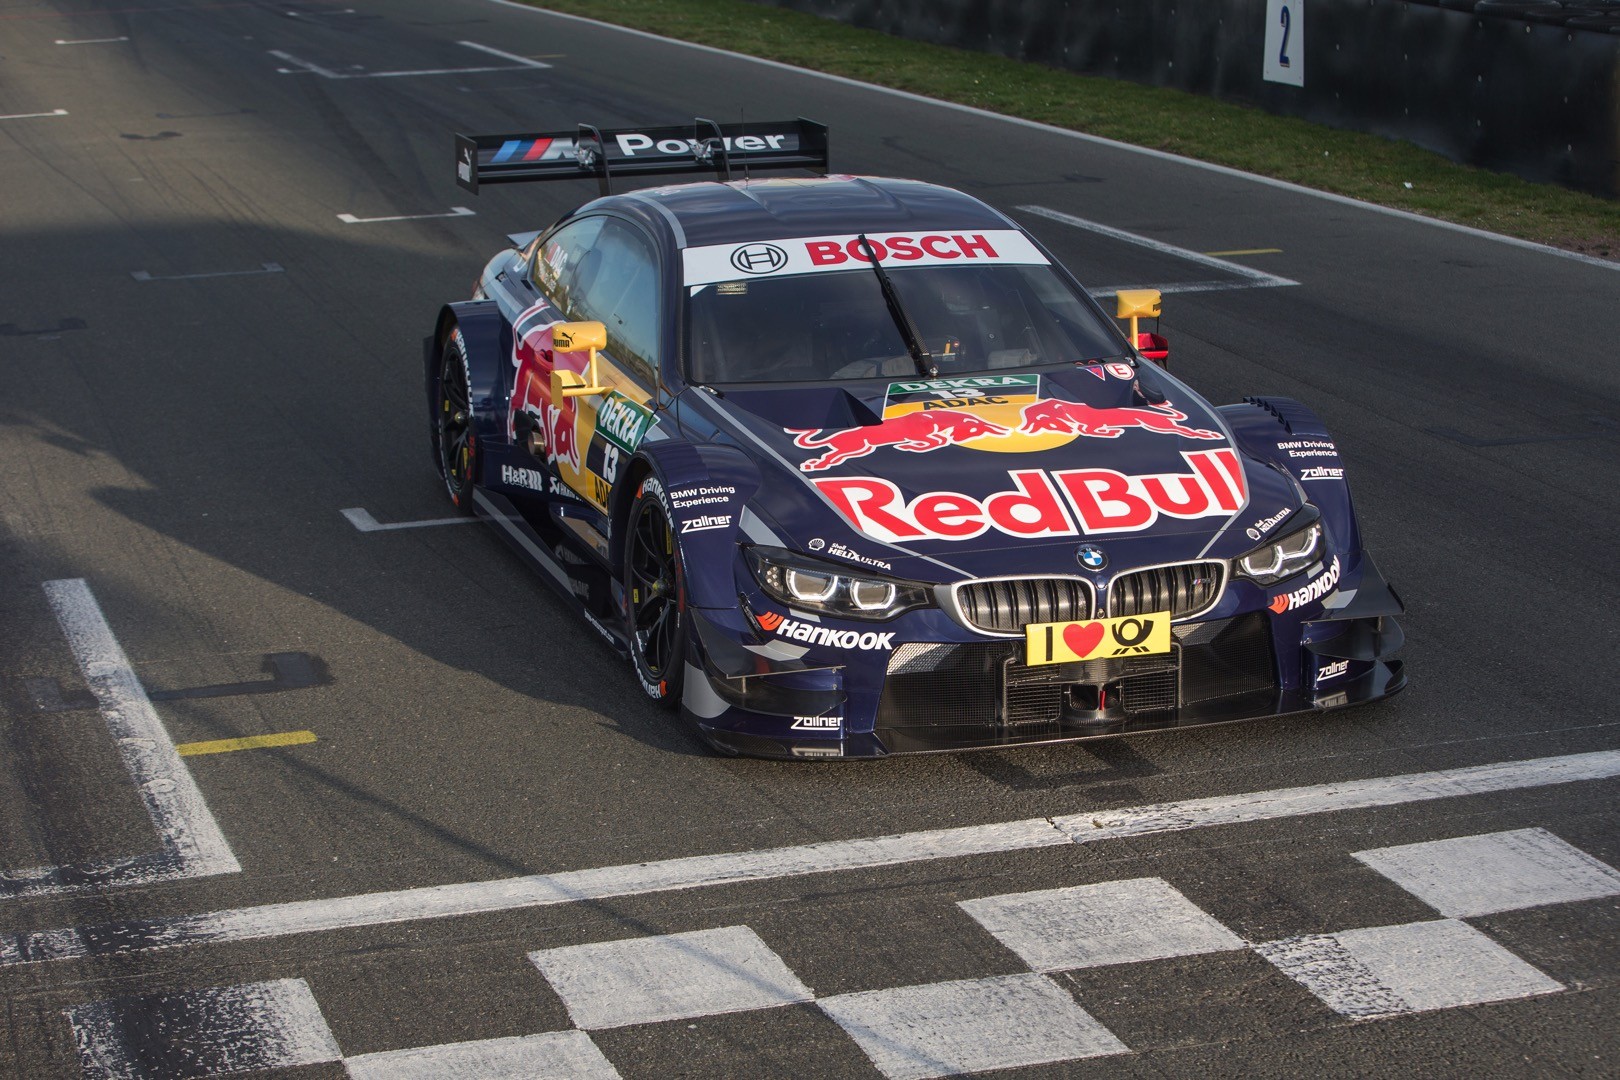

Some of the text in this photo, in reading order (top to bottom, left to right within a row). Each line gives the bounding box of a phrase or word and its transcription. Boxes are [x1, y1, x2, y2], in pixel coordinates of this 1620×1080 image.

[1279, 5, 1291, 68] 2
[804, 234, 1000, 266] BOSCH
[1113, 365, 1128, 375] E
[898, 376, 1031, 392] DEKRA
[930, 388, 986, 400] 13
[923, 396, 1009, 411] ADAC
[600, 396, 644, 448] DEKRA
[1277, 441, 1335, 450] BMW Driving
[1288, 449, 1338, 459] Experience
[603, 442, 619, 484] 13
[670, 486, 736, 500] BMW Driving
[673, 496, 730, 509] Experience
[860, 556, 892, 571] ULTRA
[1045, 625, 1054, 662] I
